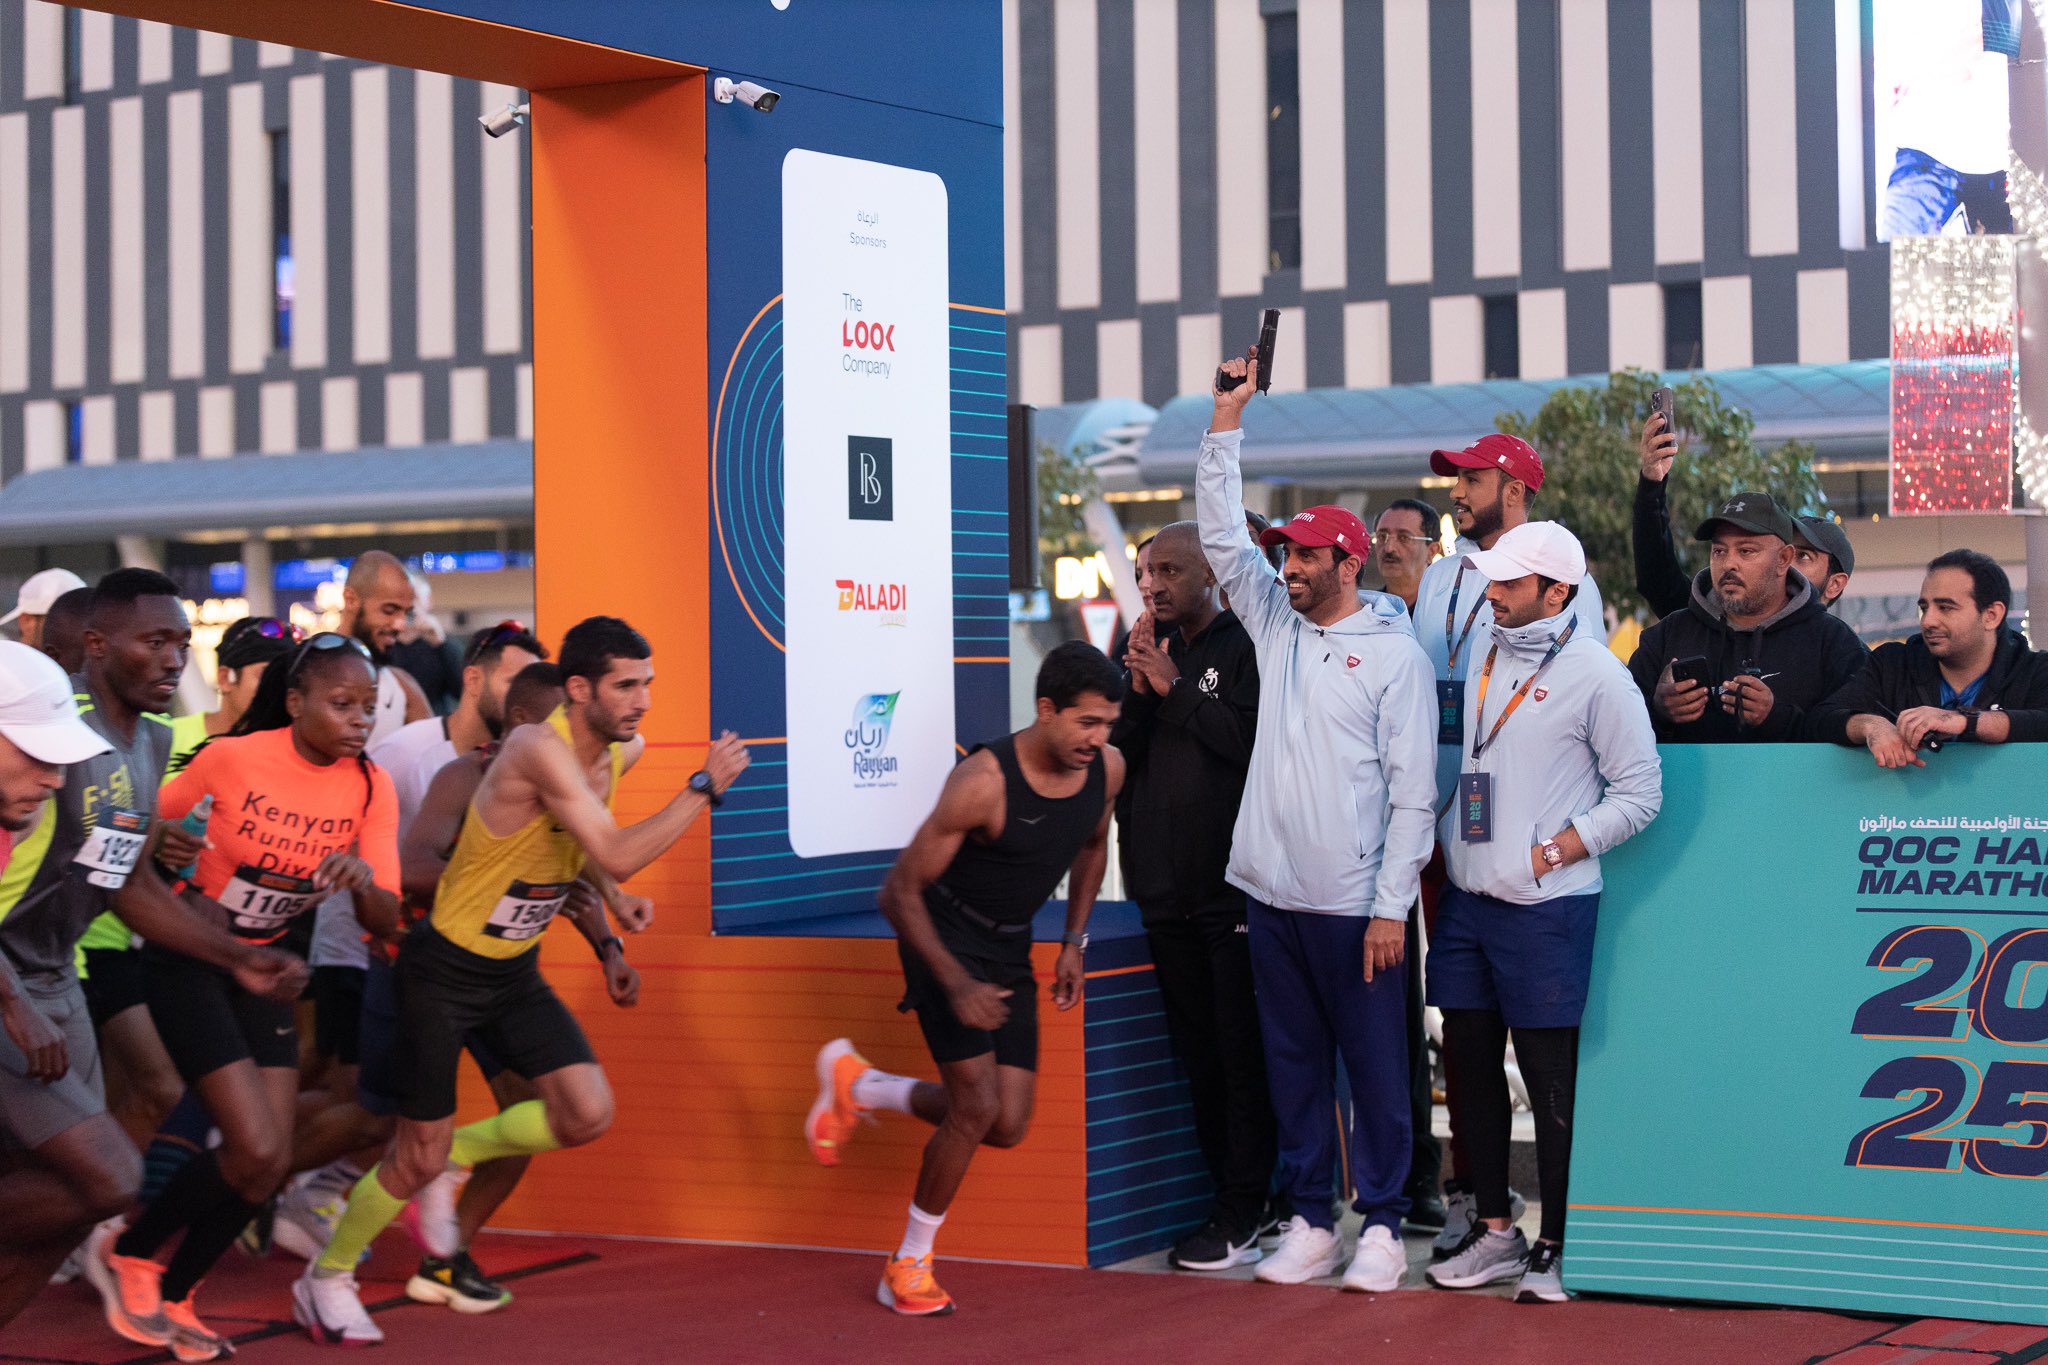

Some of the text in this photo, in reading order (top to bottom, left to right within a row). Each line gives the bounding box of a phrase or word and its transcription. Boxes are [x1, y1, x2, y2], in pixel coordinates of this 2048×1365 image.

[850, 231, 887, 248] Sponsors
[842, 292, 863, 312] The
[842, 318, 895, 352] LOOK
[842, 353, 891, 379] Company
[835, 579, 906, 611] BALADI
[853, 751, 898, 780] Rayyan
[241, 791, 353, 838] Kenyan
[1859, 814, 1907, 832] ماراثون
[1909, 816, 1957, 829] للنصف
[1960, 814, 2020, 833] الأولمبية
[1858, 835, 2048, 868] QOC HA
[241, 889, 307, 916] 1105
[1850, 924, 2048, 1046] 20
[1844, 1055, 2048, 1178] 25
